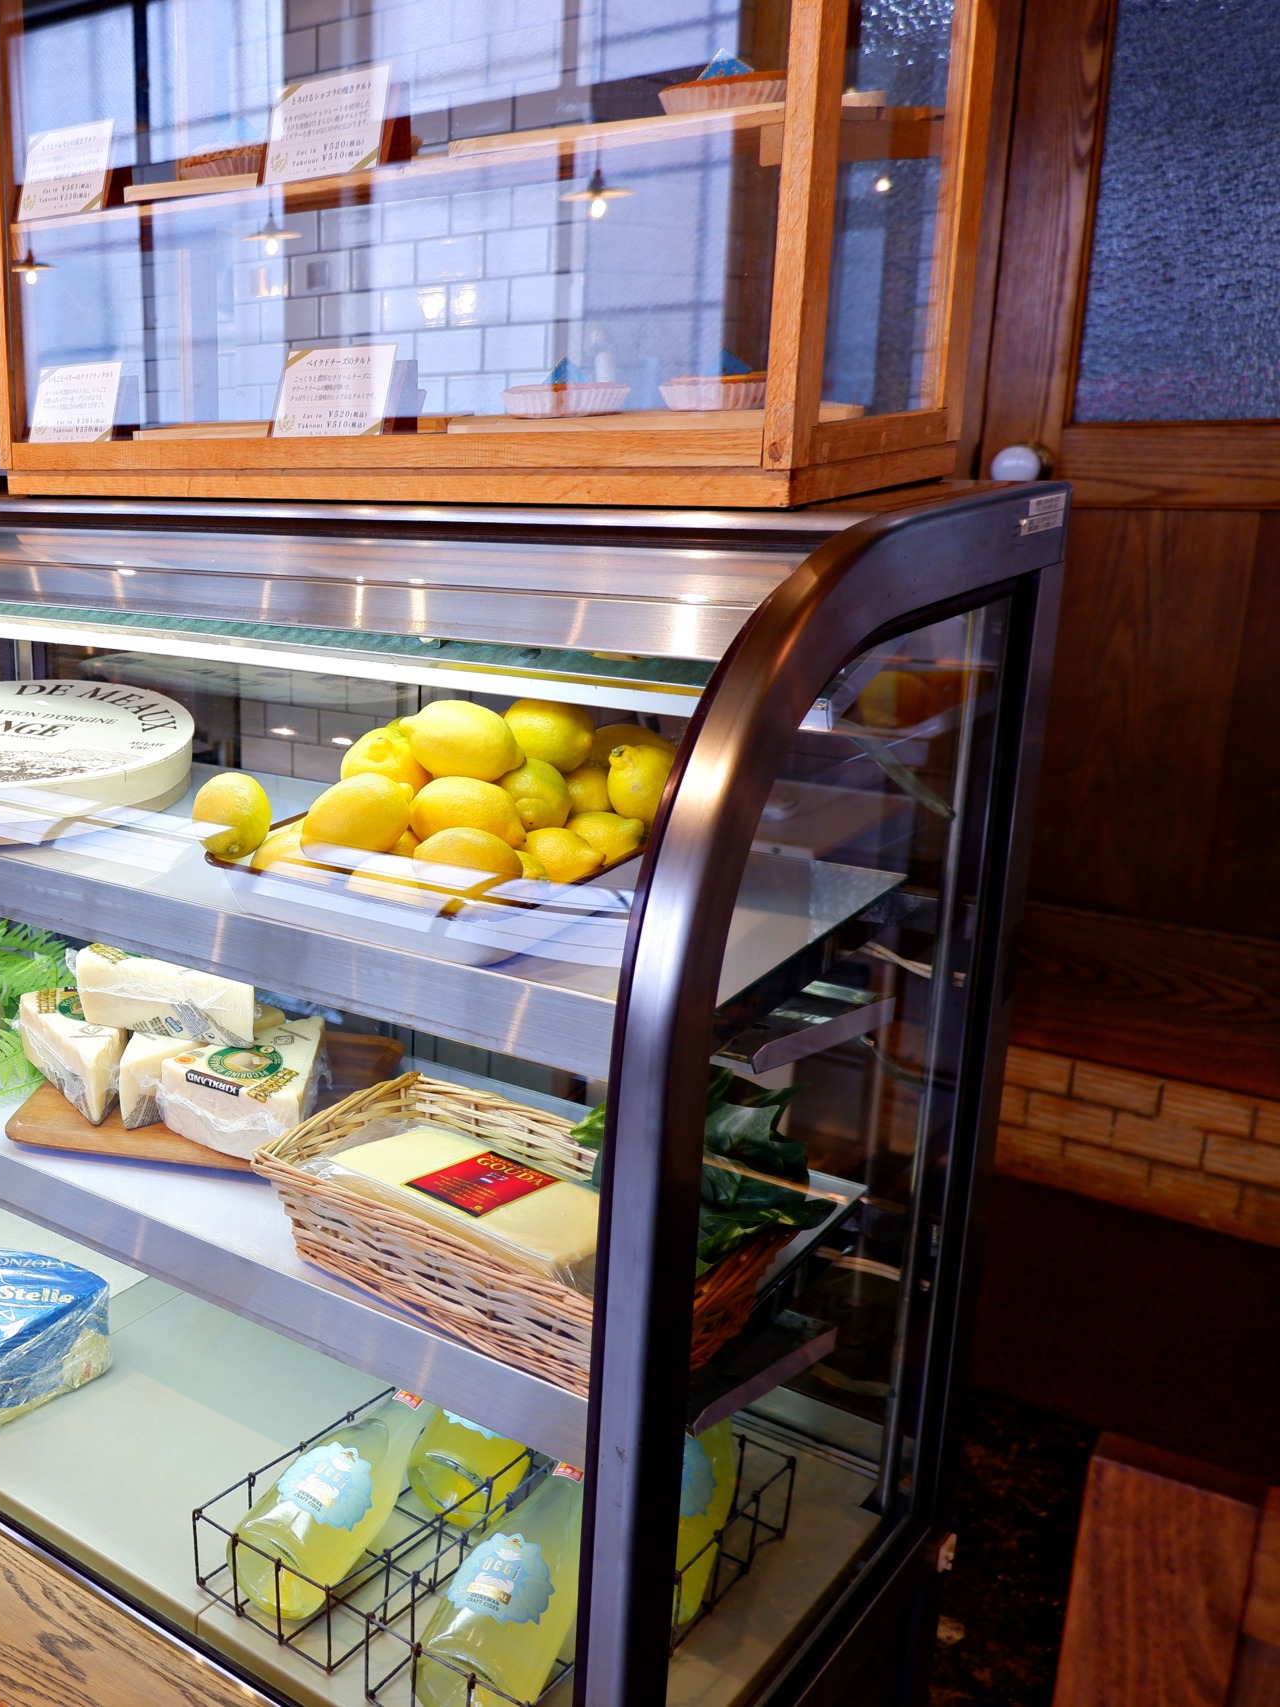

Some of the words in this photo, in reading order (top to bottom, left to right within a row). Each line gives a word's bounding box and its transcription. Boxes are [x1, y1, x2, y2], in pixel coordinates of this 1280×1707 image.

[291, 80, 372, 106] とろけるショコラの焼きタルト
[292, 158, 319, 167] Takeout
[306, 356, 371, 367] ベイクドチーズのタルト
[14, 684, 74, 696] DE
[76, 687, 177, 732] MEAUX
[187, 1072, 237, 1095] KIRKLAND
[476, 1157, 543, 1186] GOUDA
[294, 1492, 308, 1503] CRAFT
[307, 1500, 322, 1513] CIDER
[466, 1597, 483, 1605] CRAFT
[483, 1601, 500, 1612] CIDER
[470, 1592, 500, 1606] OKINAWAN
